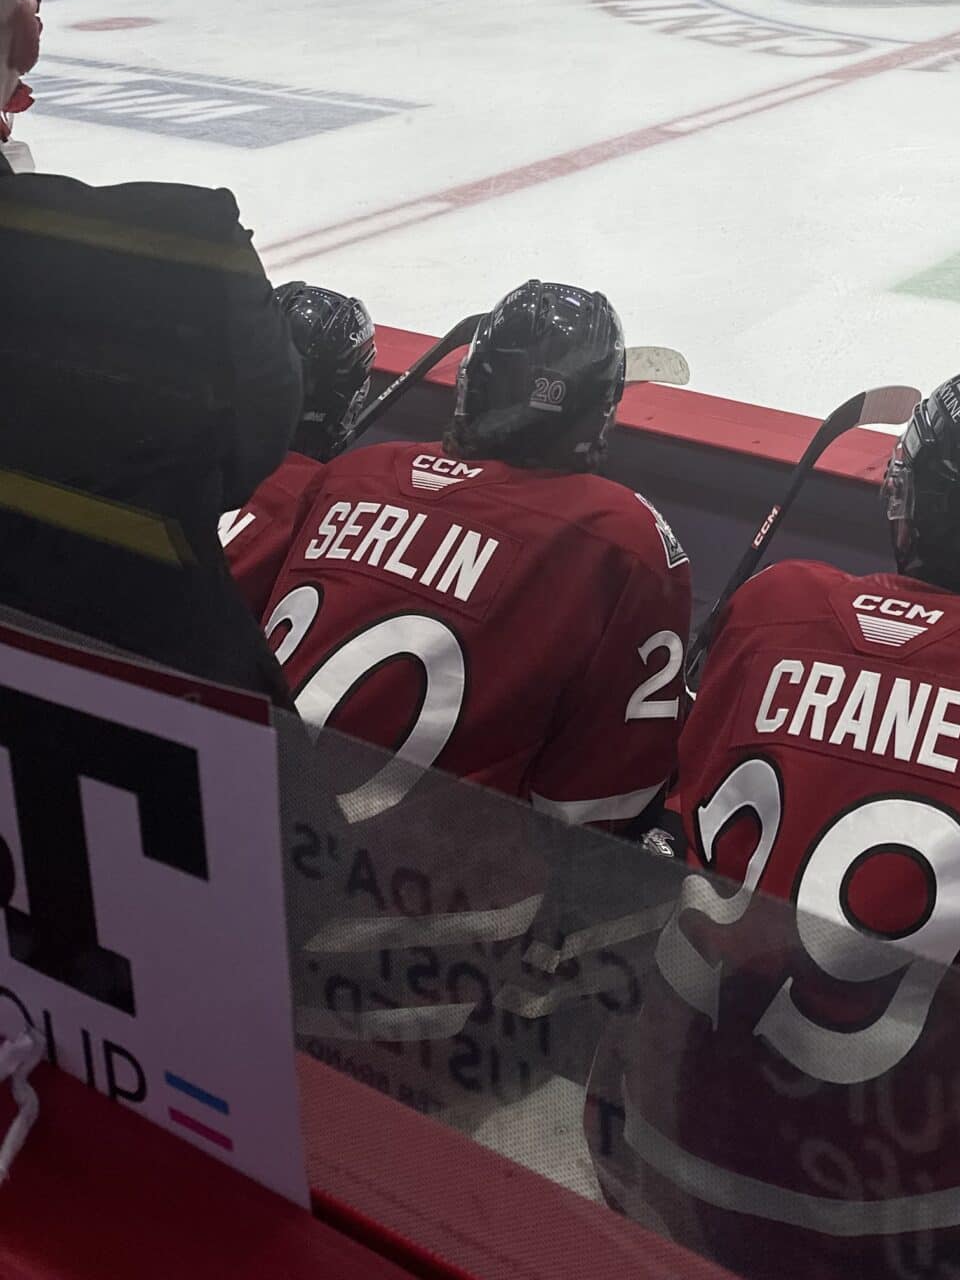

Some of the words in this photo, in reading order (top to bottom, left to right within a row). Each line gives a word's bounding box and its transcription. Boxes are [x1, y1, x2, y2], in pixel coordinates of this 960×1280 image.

[534, 377, 565, 402] 20
[411, 454, 483, 479] CCM
[753, 506, 779, 547] CCM
[304, 500, 499, 603] SERLIN
[851, 593, 945, 625] CCM
[624, 629, 684, 723] 2
